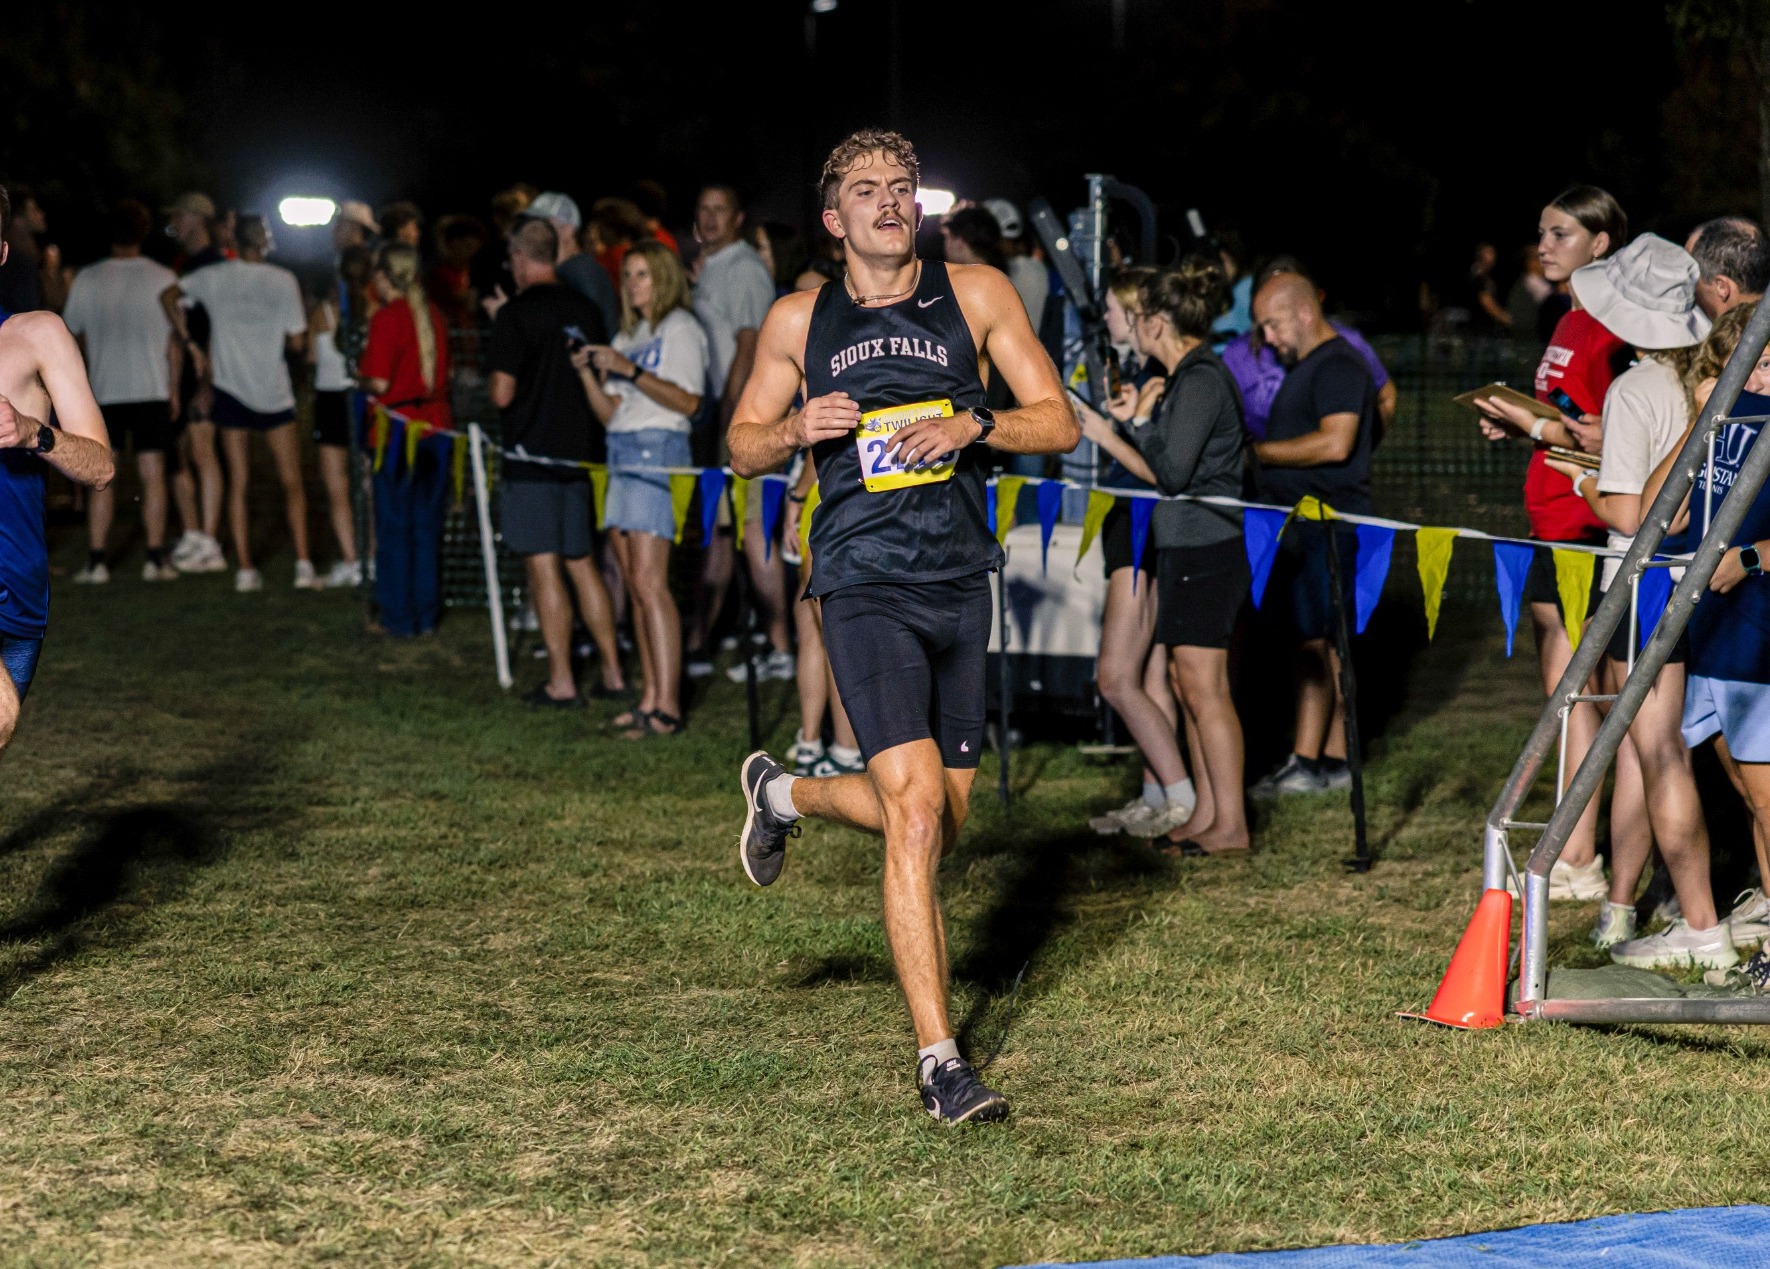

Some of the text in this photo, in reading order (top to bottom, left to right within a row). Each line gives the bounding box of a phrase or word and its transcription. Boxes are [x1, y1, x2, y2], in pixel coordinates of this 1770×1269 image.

[830, 337, 948, 377] SIOUX FALLS
[1698, 480, 1724, 495] TENIS
